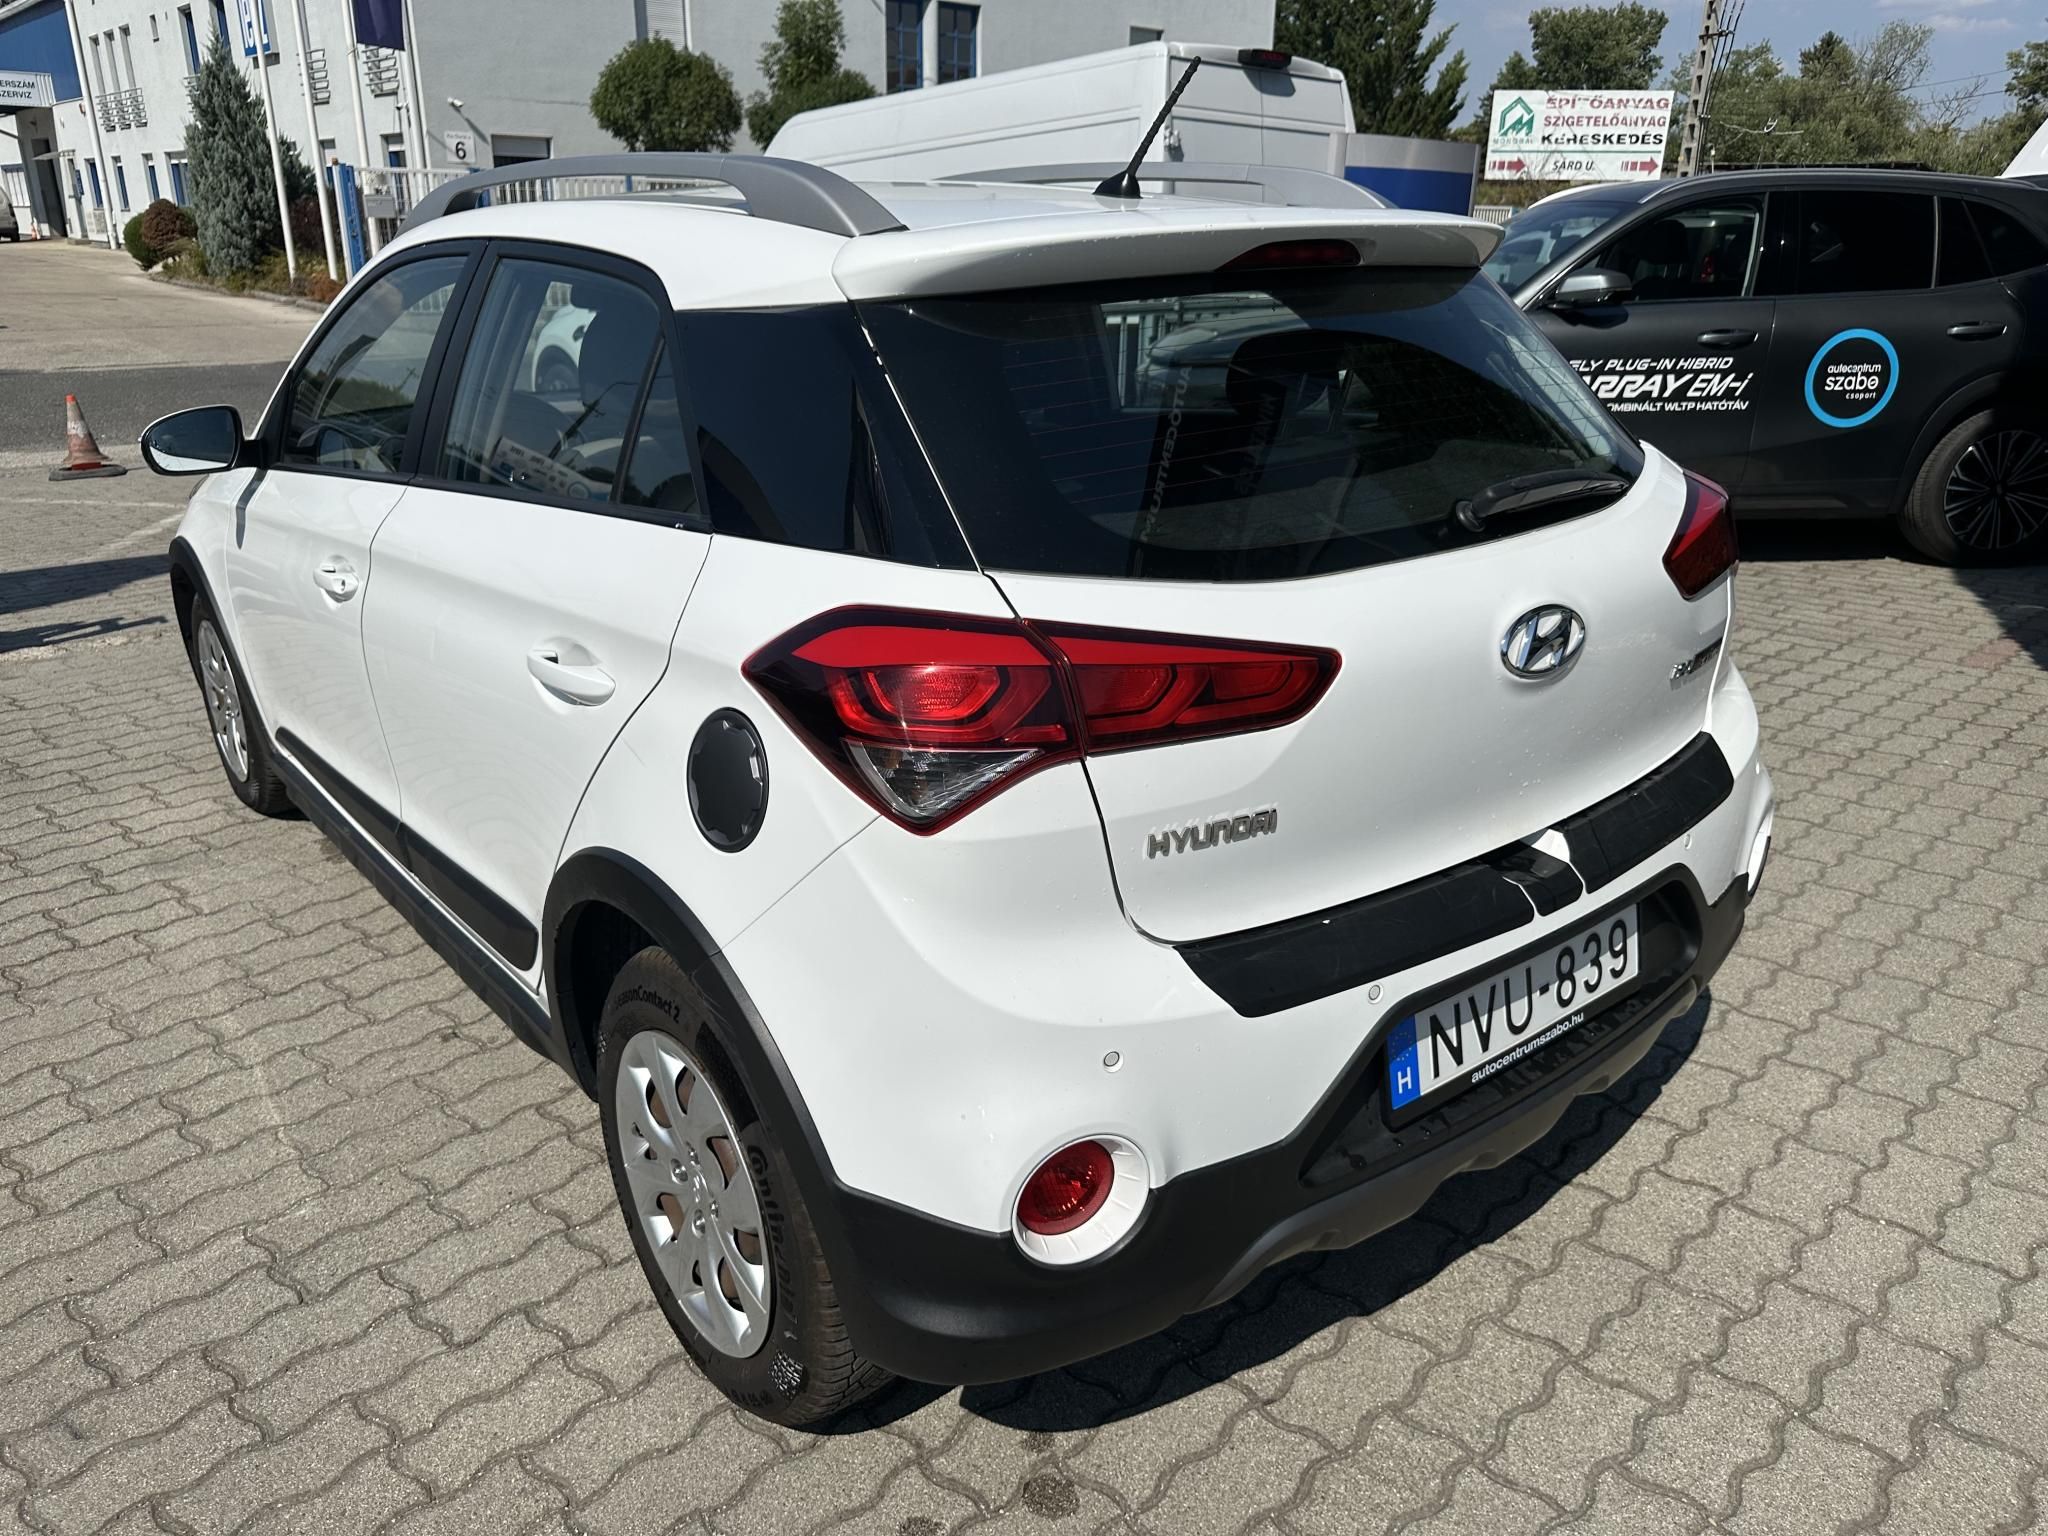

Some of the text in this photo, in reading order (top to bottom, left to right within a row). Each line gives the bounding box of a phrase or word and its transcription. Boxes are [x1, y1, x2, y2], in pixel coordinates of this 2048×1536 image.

[0, 90, 32, 99] ZERVIZ
[1544, 113, 1667, 127] SZIGETELŐANYAG
[455, 141, 467, 160] 6
[1604, 358, 1676, 372] PLUG-IN
[1676, 356, 1734, 370] HIBRID
[1827, 363, 1882, 373] autocentrum
[1582, 372, 1754, 398] RRAY EM-i
[1664, 401, 1696, 411] WLTP
[1696, 398, 1750, 411] HATÓTÁV
[1845, 391, 1877, 401] csoport
[1146, 807, 1278, 860] HYUNDAI
[1428, 918, 1629, 1081] NVU-839
[673, 1004, 681, 1024] 2
[1470, 1011, 1585, 1084] autocentrumszabo.hu
[1396, 1066, 1413, 1095] H
